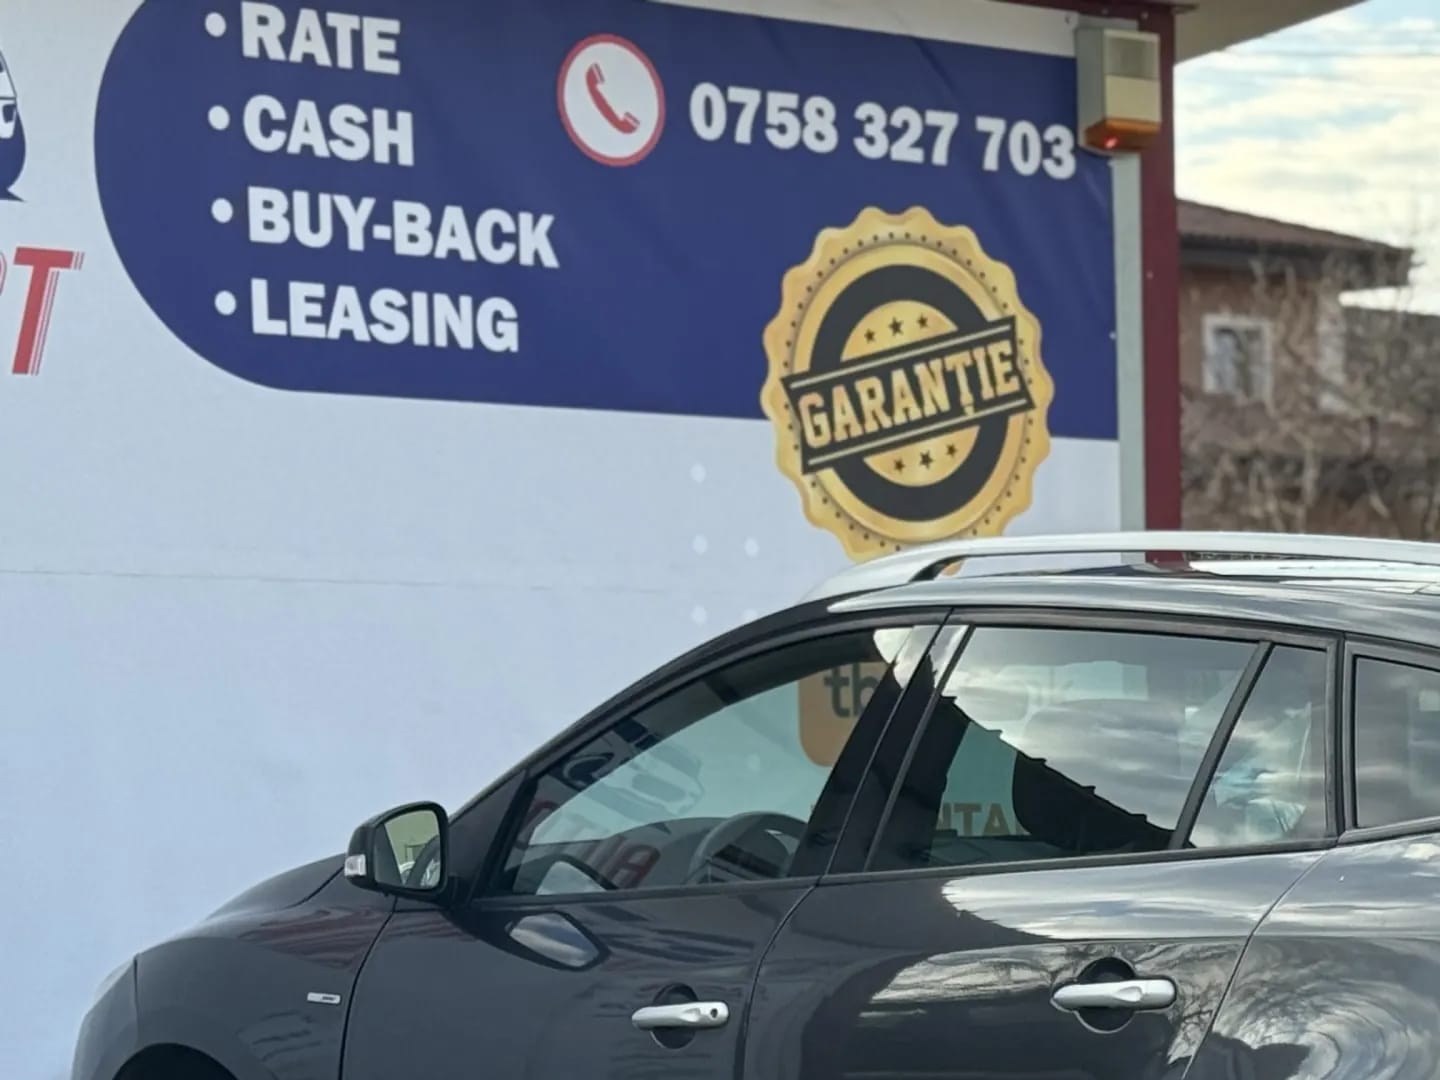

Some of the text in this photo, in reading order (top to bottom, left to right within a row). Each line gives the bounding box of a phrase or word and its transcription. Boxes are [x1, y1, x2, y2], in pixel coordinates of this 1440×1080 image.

[241, 1, 400, 75] RATE
[243, 94, 415, 166] CASH
[689, 82, 1077, 180] 0758 327 703
[247, 186, 560, 268] BUY-BACK
[251, 278, 519, 352] LEASING
